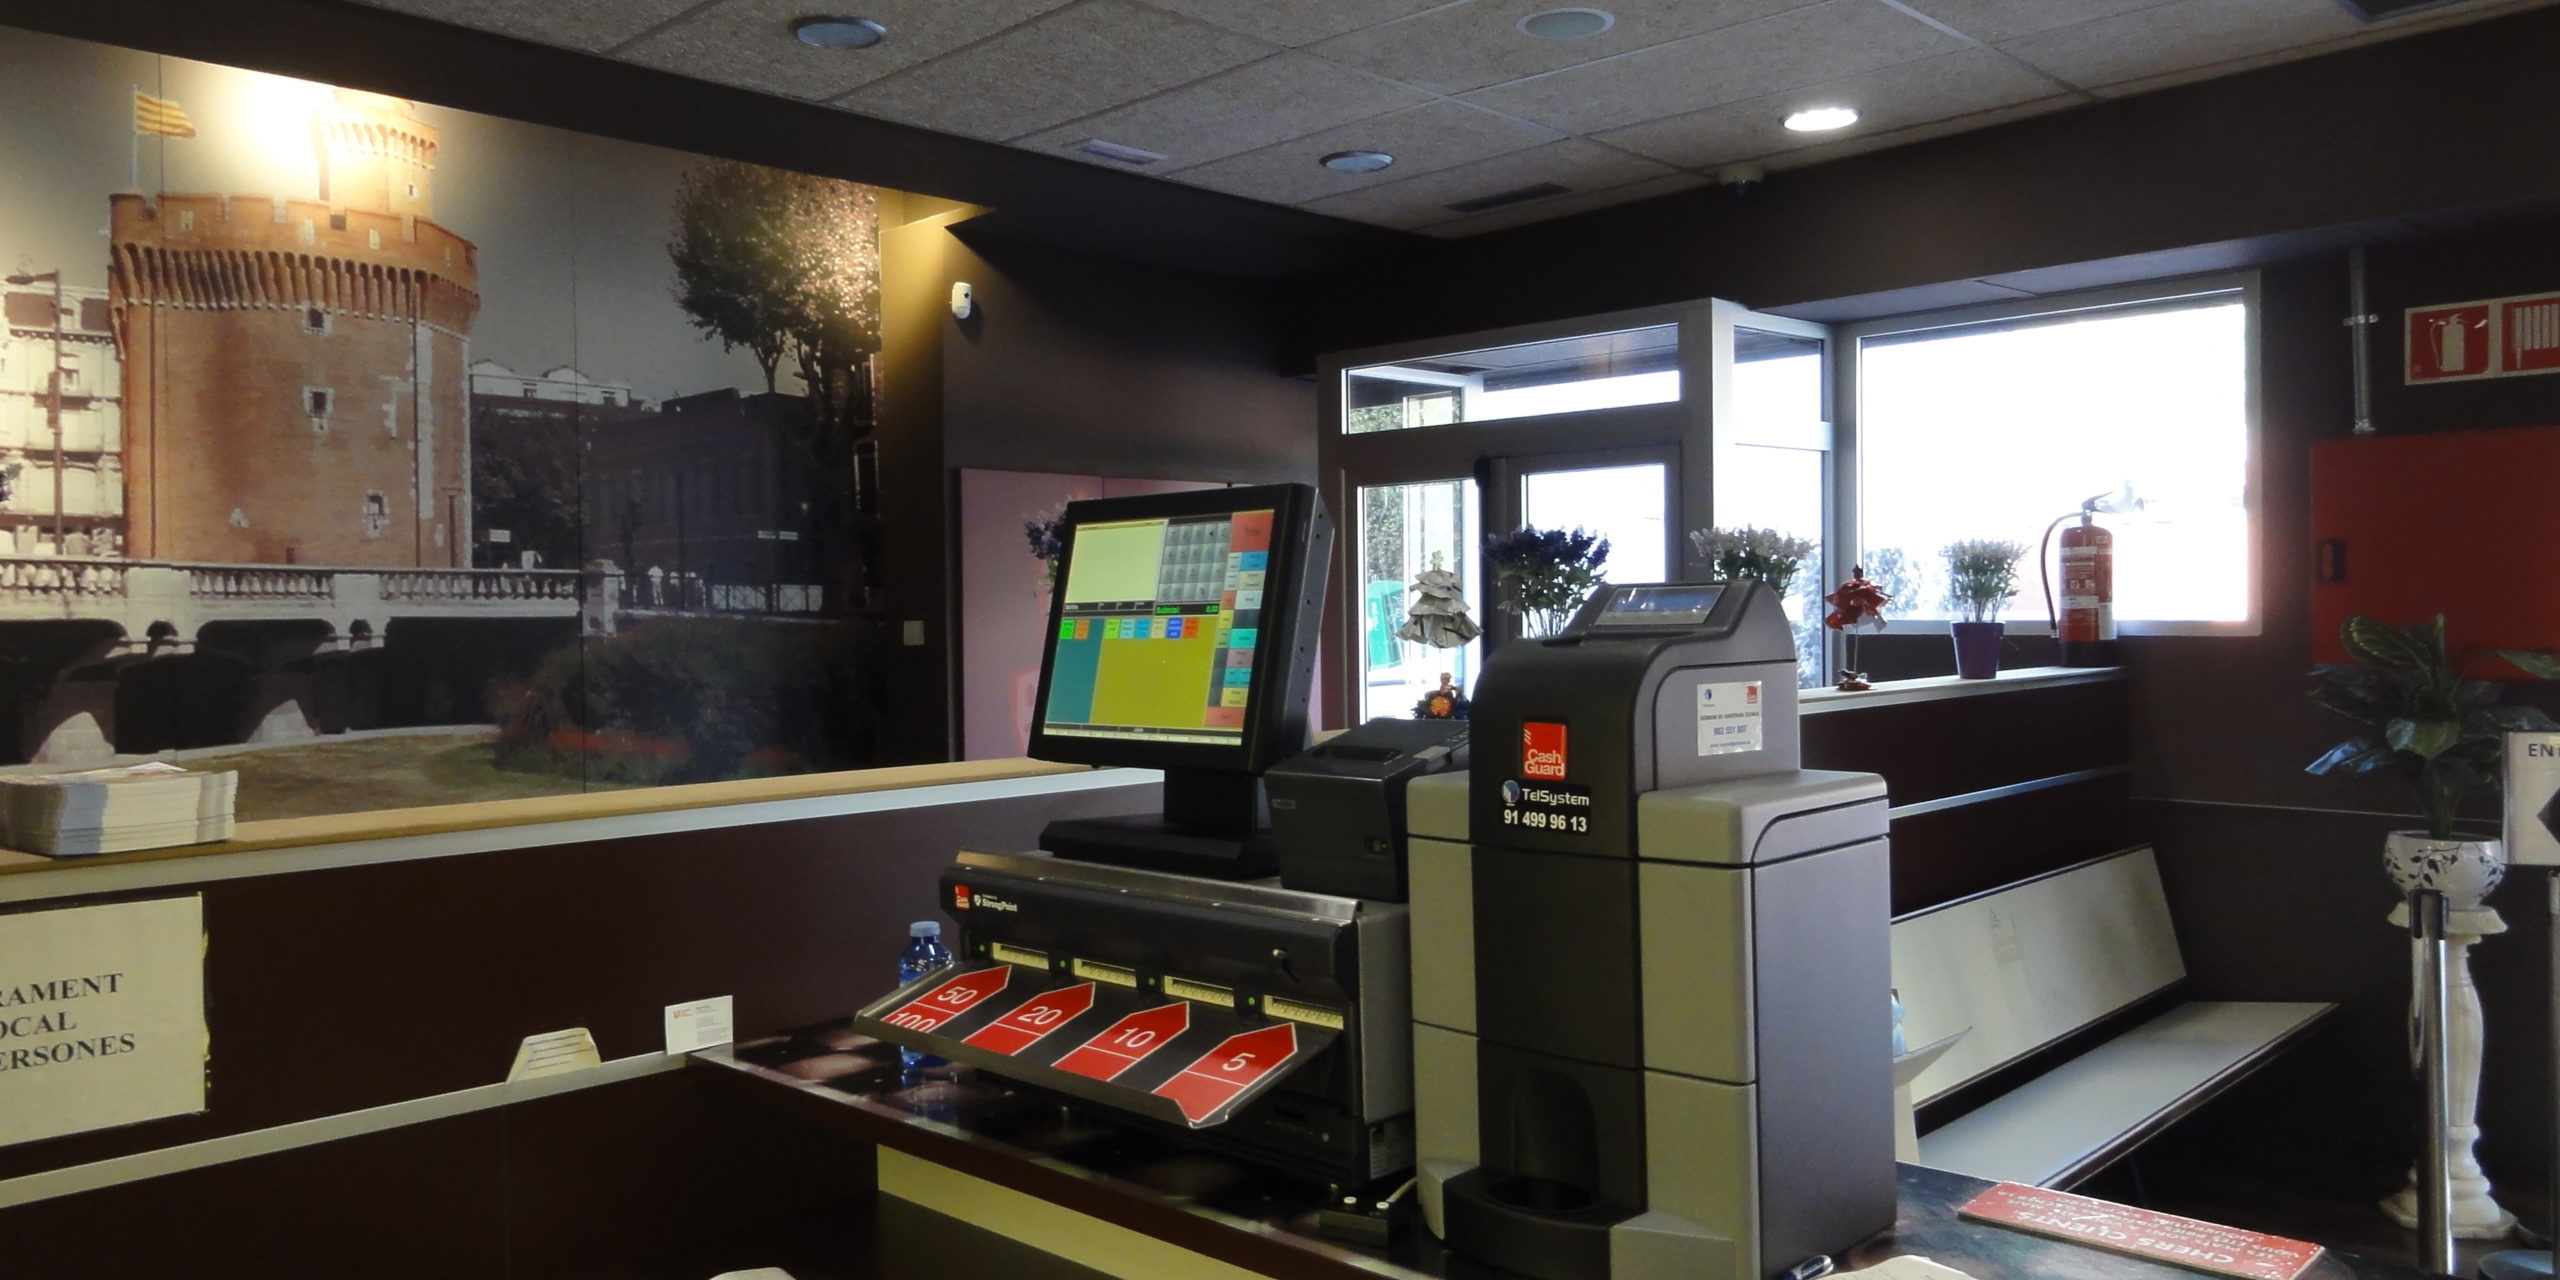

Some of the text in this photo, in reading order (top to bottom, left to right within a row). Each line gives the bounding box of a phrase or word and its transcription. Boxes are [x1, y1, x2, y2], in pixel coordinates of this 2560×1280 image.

[1528, 748, 1561, 764] Cash
[2529, 743, 2560, 757] EN
[1524, 760, 1565, 777] Guard
[1522, 788, 1590, 806] TelSystem
[1504, 809, 1587, 832] 91 499 96 13
[937, 986, 977, 1005] 50
[889, 1011, 936, 1032] 100
[1017, 1005, 1062, 1025] 20
[1113, 1027, 1156, 1048] 10
[1221, 1052, 1256, 1071] 5
[2016, 1211, 2236, 1264] CHERS CLIENTS
